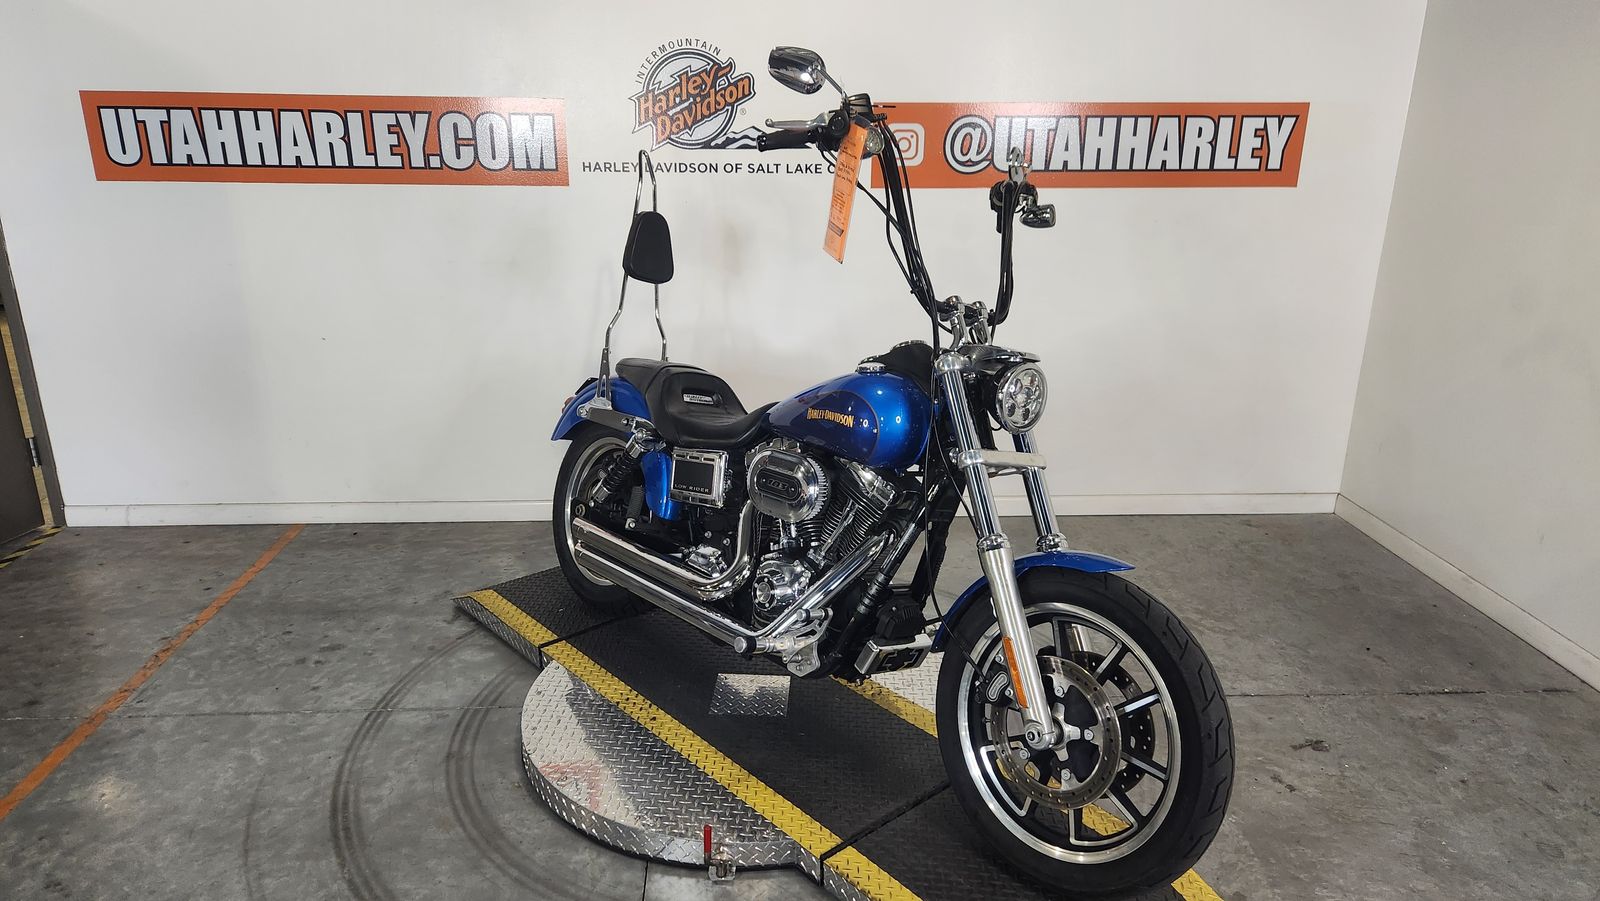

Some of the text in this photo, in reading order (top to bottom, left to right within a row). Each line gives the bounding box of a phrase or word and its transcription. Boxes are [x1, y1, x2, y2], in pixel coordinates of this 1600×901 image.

[635, 38, 721, 84] INTERMOUNTAIN
[655, 76, 750, 145] Davidson
[97, 105, 558, 171] UTAHHARLEY.COM
[943, 114, 1299, 174] @UTAHHARLEY
[582, 161, 639, 173] HARLEY
[723, 163, 743, 174] OF
[747, 163, 781, 174] SALT
[786, 163, 823, 174] LAKE
[689, 485, 709, 493] RIDER
